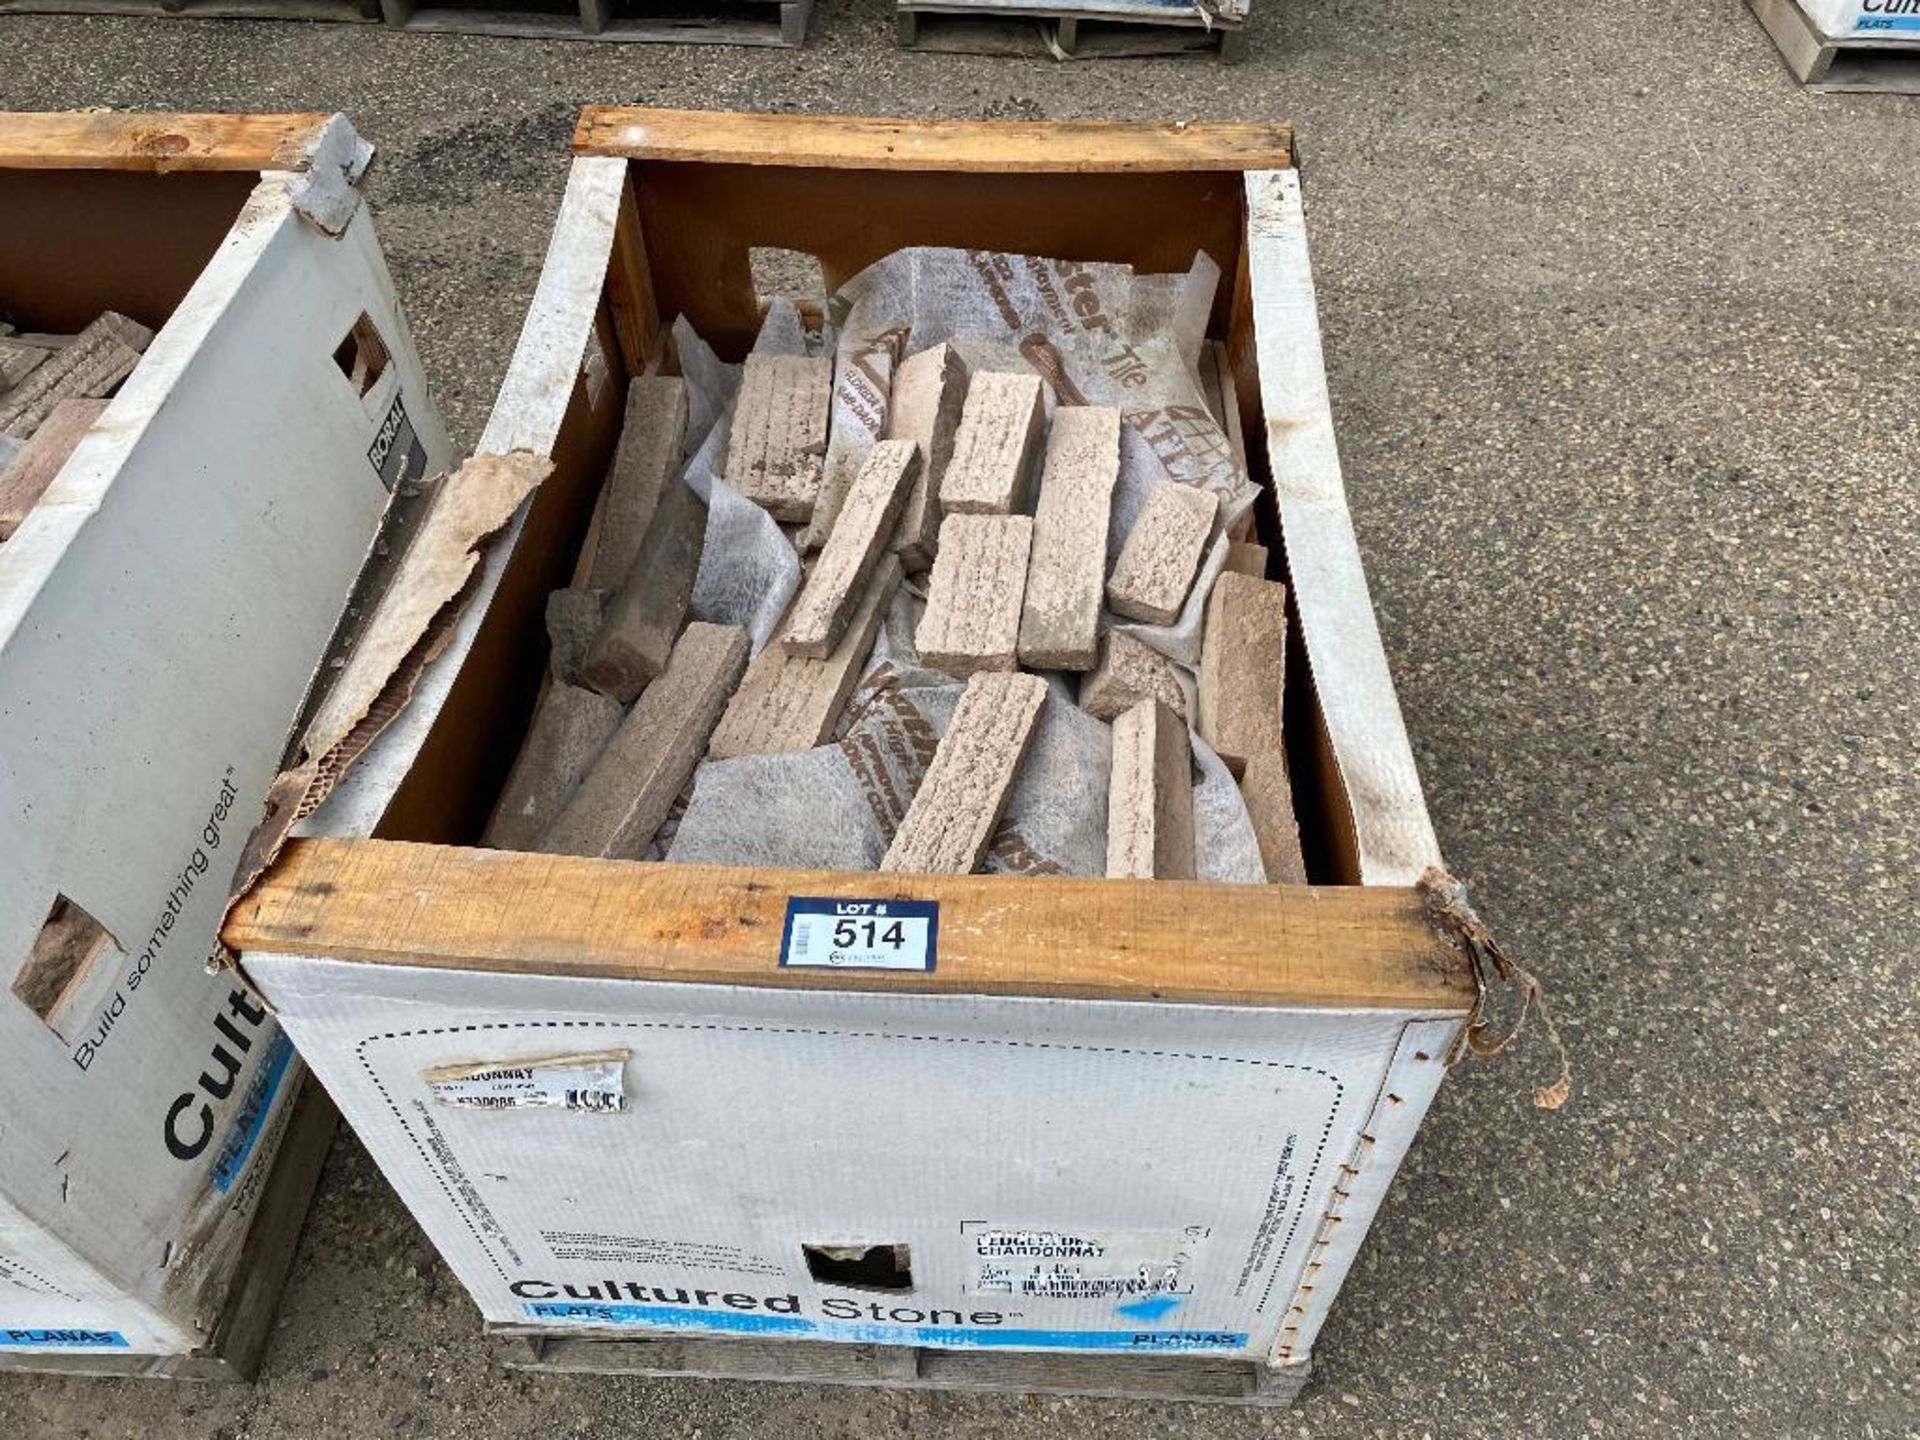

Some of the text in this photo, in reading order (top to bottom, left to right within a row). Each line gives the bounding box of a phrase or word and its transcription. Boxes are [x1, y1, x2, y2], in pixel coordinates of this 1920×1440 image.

[836, 904, 887, 915] LOT #
[833, 919, 906, 950] 514
[72, 992, 127, 1072] Build
[126, 848, 209, 991] something
[165, 990, 266, 1161] Cult
[976, 1246, 1106, 1257] CHARDONNAY
[509, 1280, 801, 1315] Cultured
[6, 1330, 115, 1344] PLANAS
[535, 1305, 1236, 1346] FLATS PLANAS
